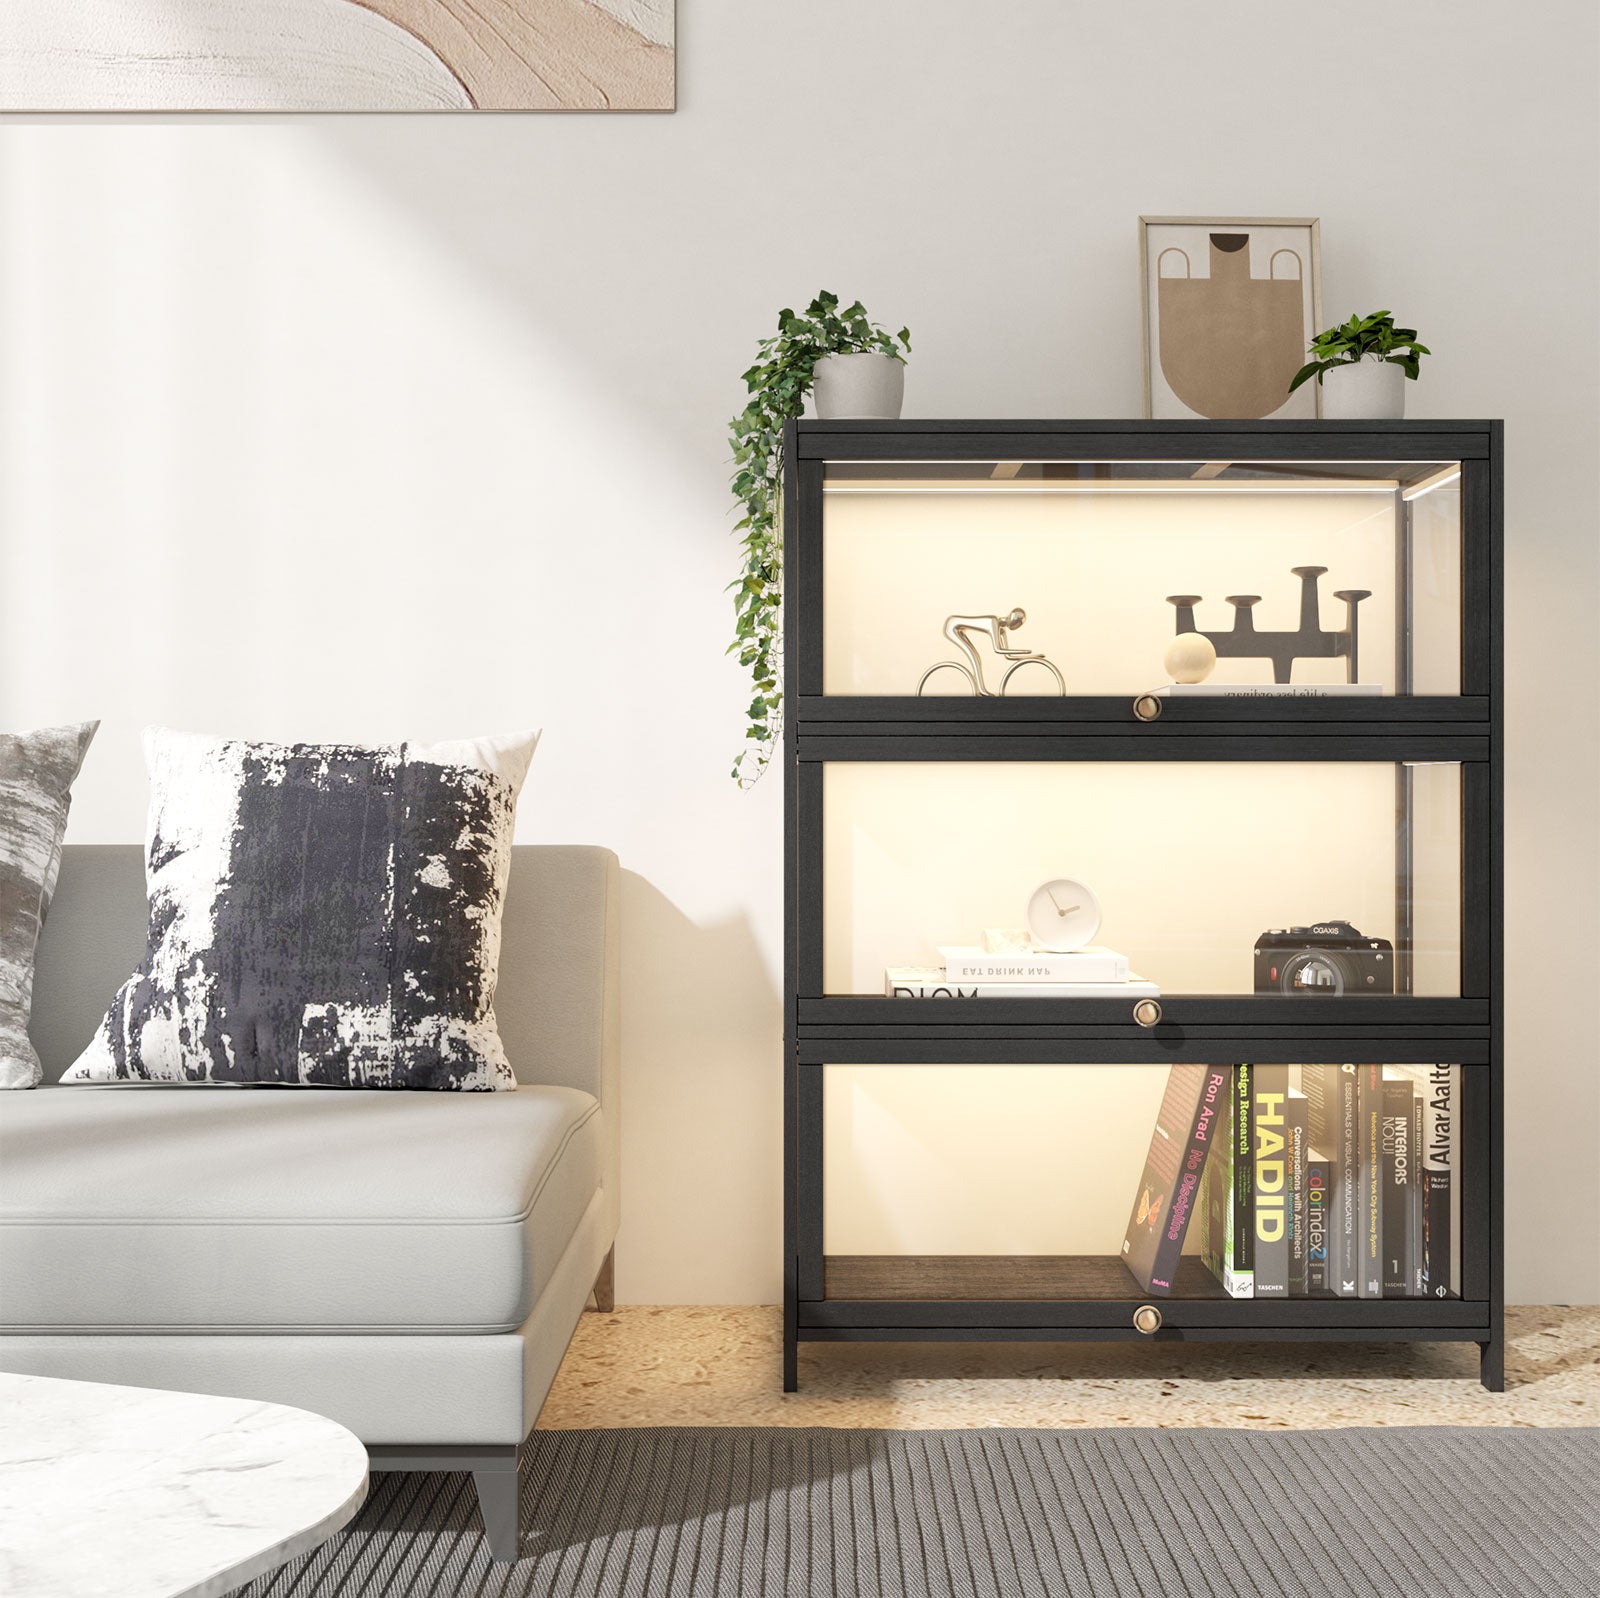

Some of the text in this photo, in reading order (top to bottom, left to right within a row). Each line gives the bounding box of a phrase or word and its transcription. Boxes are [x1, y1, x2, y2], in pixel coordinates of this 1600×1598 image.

[1313, 926, 1339, 934] CGAXIS
[1238, 1064, 1249, 1097] esign
[1240, 1100, 1249, 1155] Research
[1345, 1129, 1352, 1140] OF
[1383, 1116, 1394, 1154] NOW!
[1429, 1113, 1450, 1165] Alvar
[1168, 1073, 1224, 1240] Ron Arad No Discipline
[1256, 1093, 1284, 1242] HADID
[1395, 1117, 1407, 1185] INTERIORS
[1294, 1127, 1302, 1259] Conversations with Architects
[1369, 1195, 1377, 1207] City
[1369, 1208, 1377, 1232] Subway
[1369, 1234, 1377, 1258] System
[1392, 1260, 1398, 1273] 1
